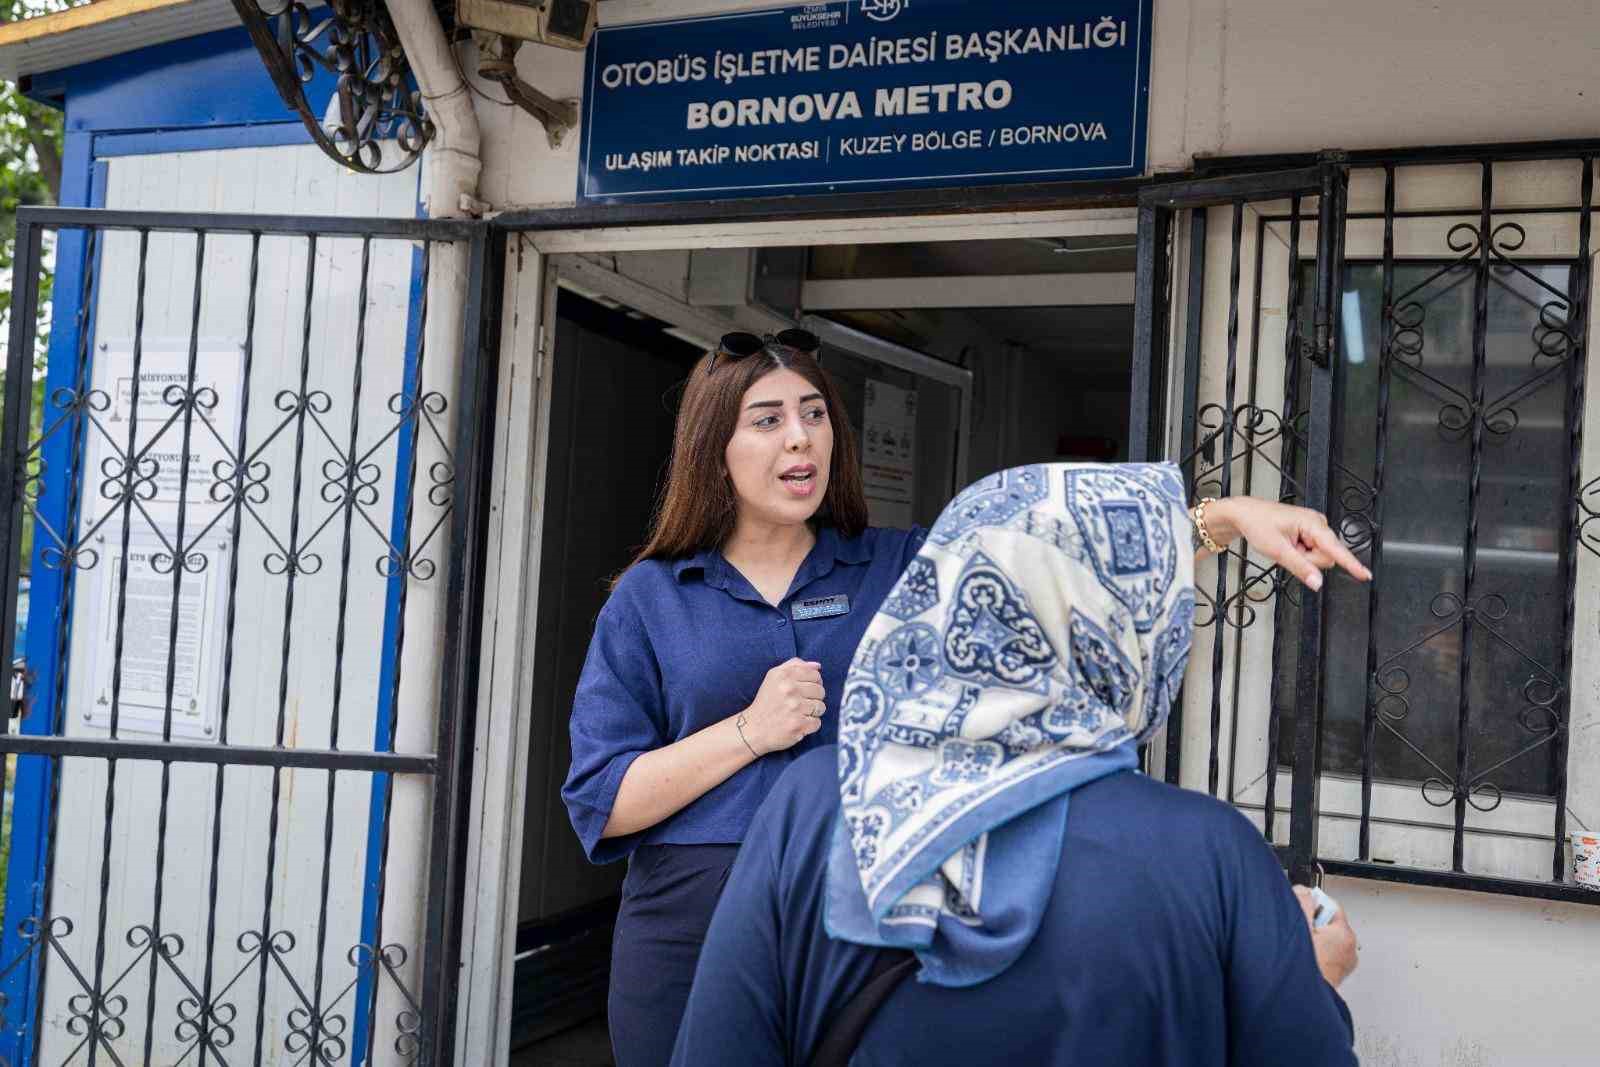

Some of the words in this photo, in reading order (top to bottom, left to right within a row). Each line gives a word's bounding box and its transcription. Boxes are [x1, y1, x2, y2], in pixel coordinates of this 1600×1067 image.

[602, 54, 707, 88] OTOBÜS
[713, 46, 821, 84] İŞLETME
[829, 31, 937, 69] DAİRESİ
[945, 16, 1127, 63] BAŞKANLIĞI
[687, 91, 863, 129] BORNOVA
[874, 79, 1012, 117] METRO
[605, 151, 672, 172] ULAŞIM
[677, 144, 730, 166] TAKİP
[735, 140, 819, 162] NOKTASI
[840, 134, 907, 156] KUZEY
[911, 129, 982, 152] BÖLGE
[1000, 122, 1108, 146] BORNOVA
